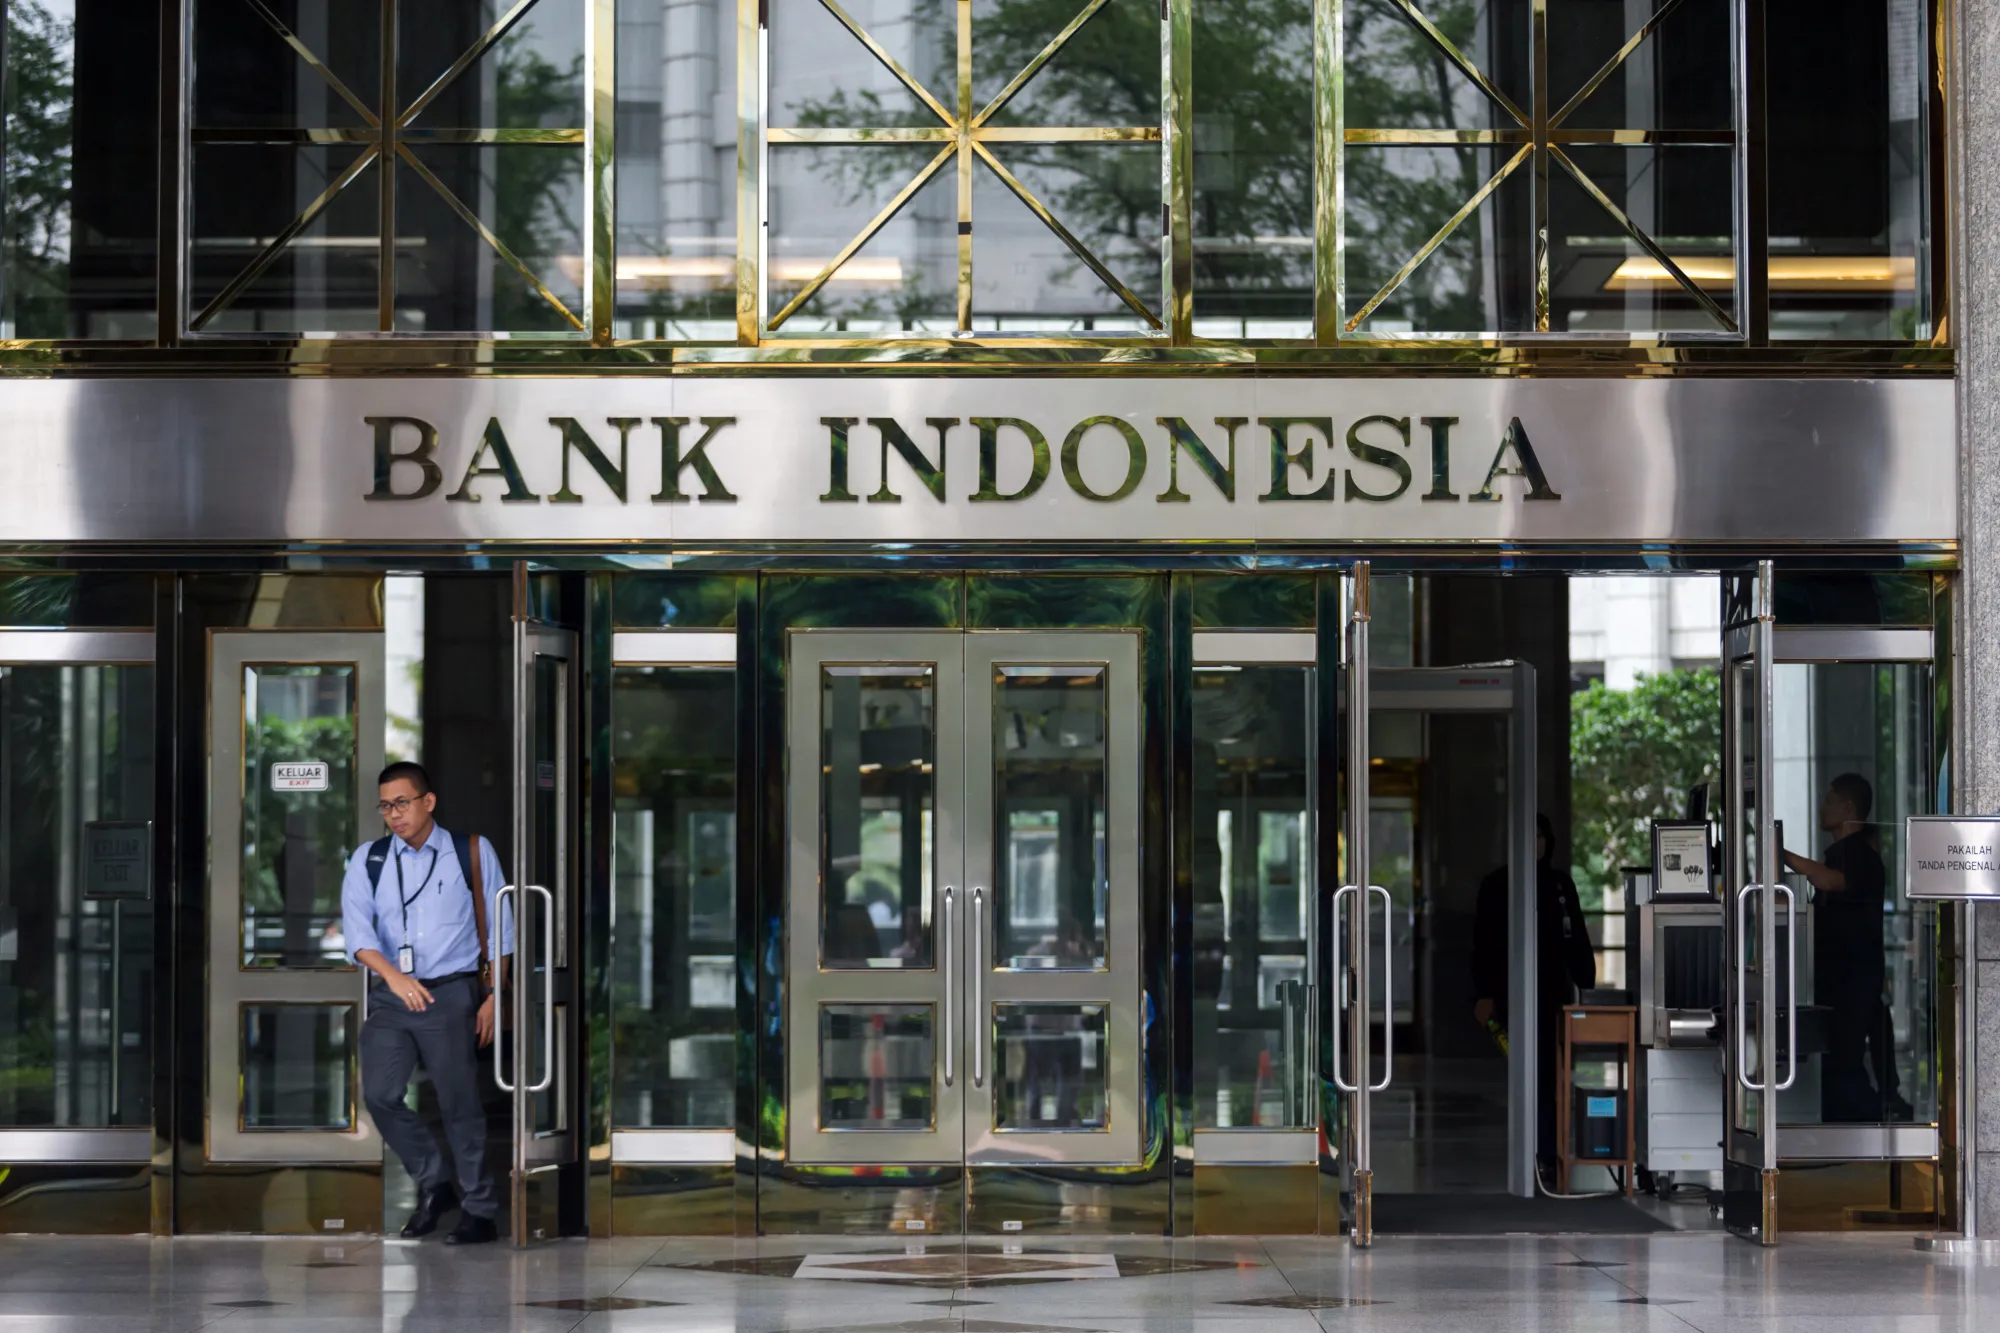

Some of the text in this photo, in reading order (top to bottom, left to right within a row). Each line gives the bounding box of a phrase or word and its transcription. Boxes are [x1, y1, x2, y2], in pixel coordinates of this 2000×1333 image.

[363, 415, 1562, 504] BANK INDONESIA
[278, 767, 321, 777] KELUAR
[1947, 845, 1992, 855] PAKAILAH
[1917, 861, 1945, 871] TANDA
[1947, 861, 1995, 871] PENGENAL
